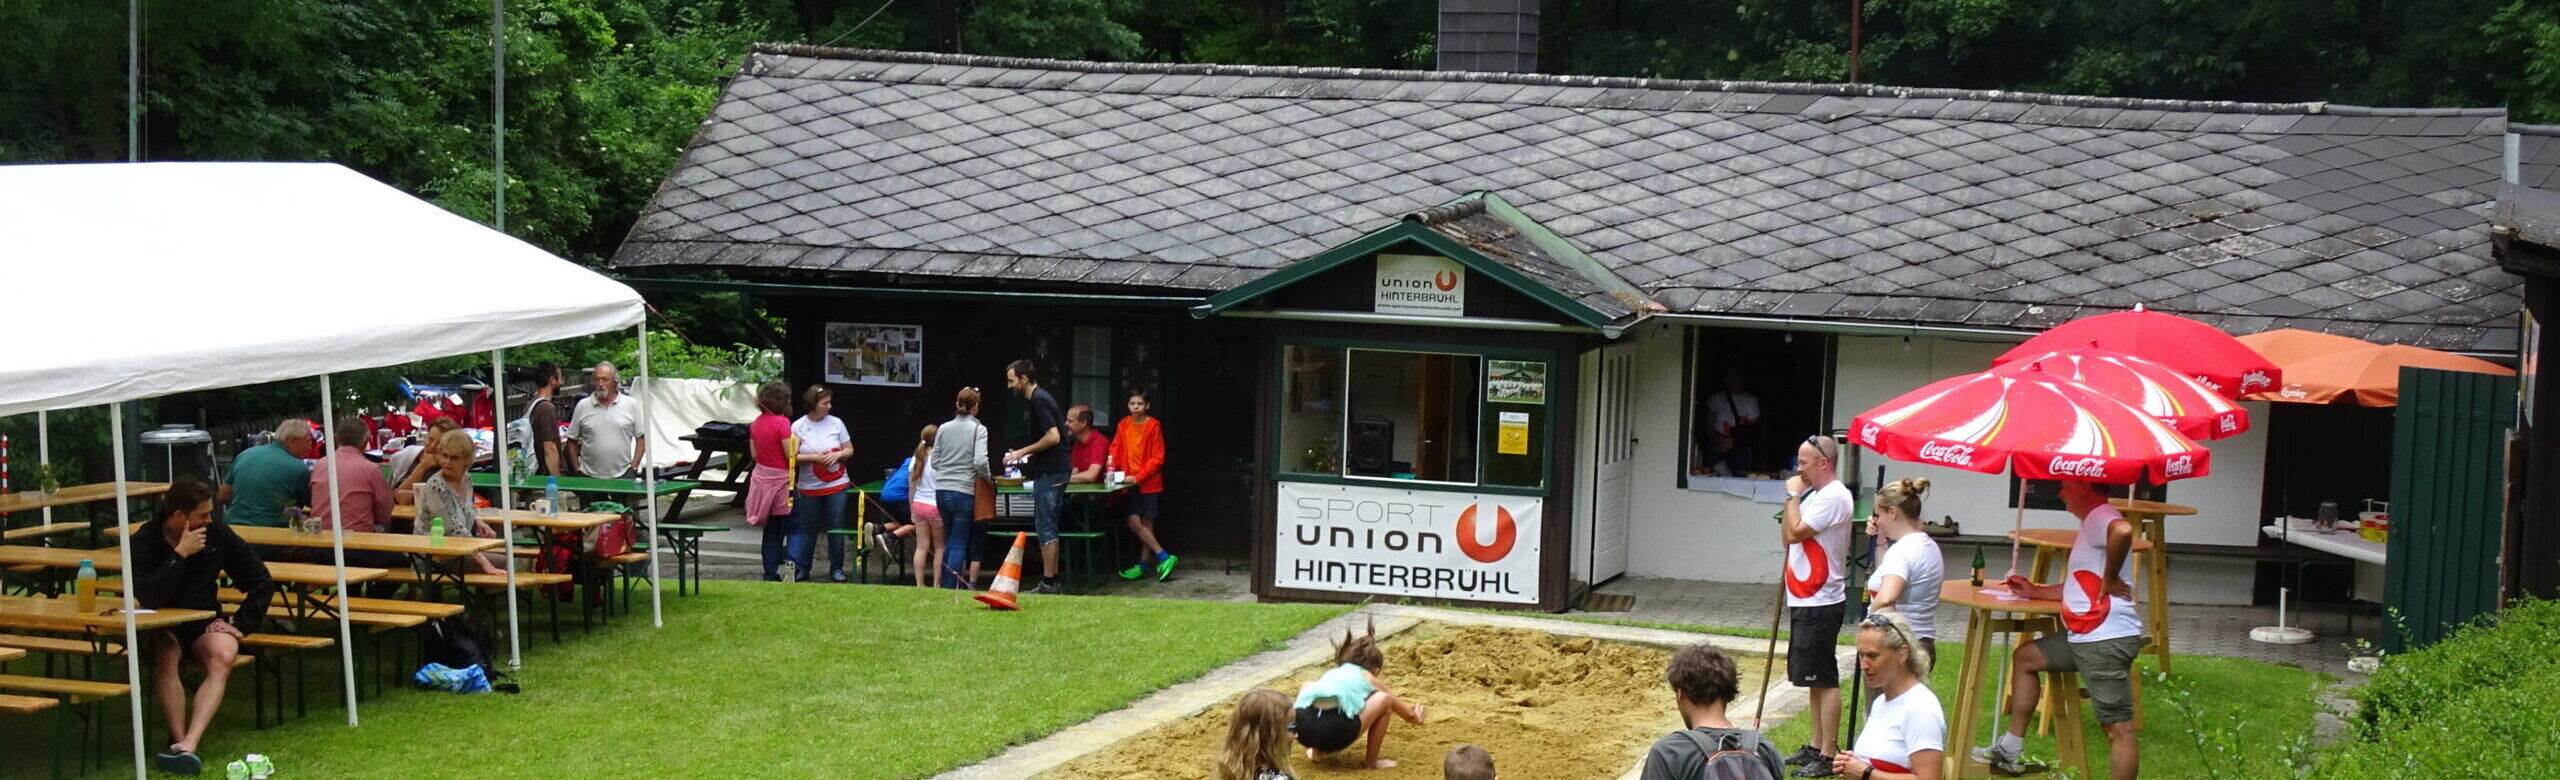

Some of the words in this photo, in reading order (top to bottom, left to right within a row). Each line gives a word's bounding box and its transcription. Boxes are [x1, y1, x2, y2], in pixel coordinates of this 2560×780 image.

[1381, 278, 1433, 290] union
[1296, 496, 1445, 527] SPORT
[1296, 524, 1443, 554] union
